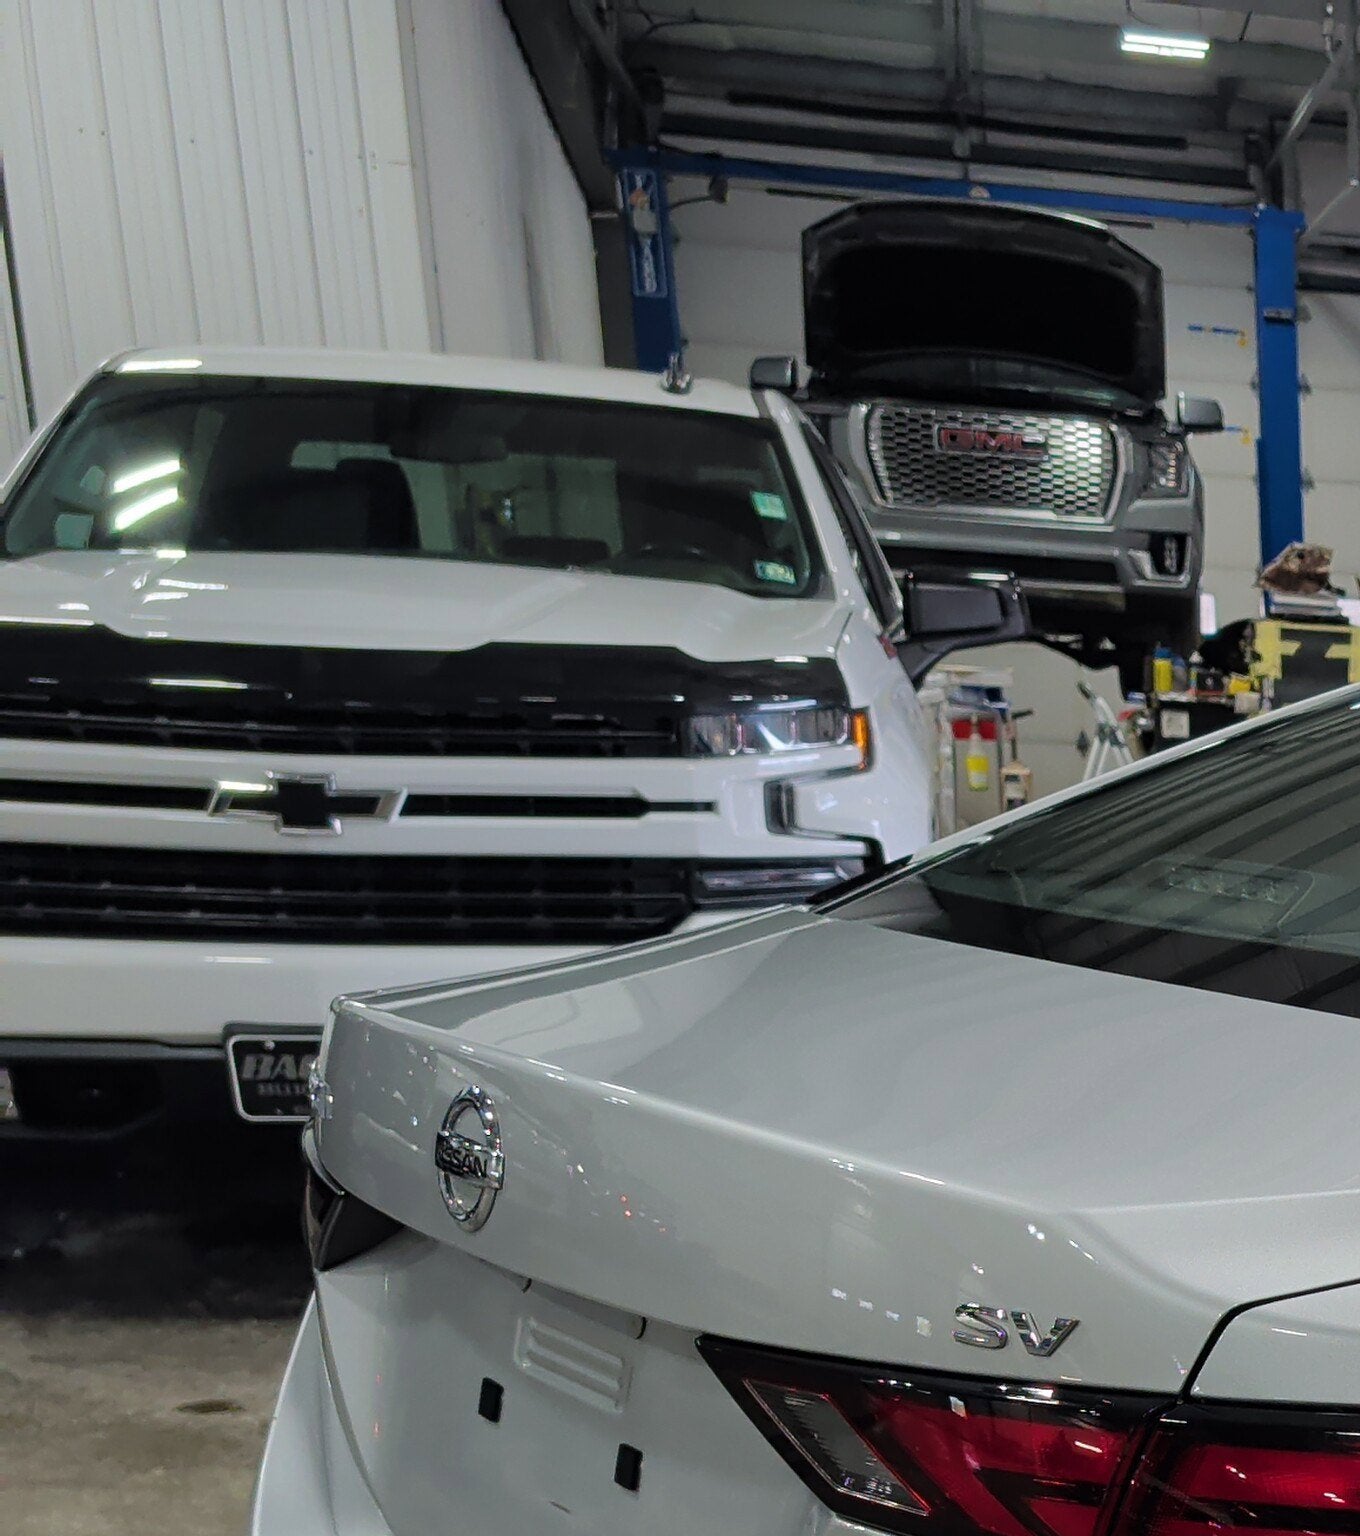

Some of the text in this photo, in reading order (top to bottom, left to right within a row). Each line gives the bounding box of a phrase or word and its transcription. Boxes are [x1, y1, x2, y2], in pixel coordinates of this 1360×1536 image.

[941, 428, 1045, 456] GMC
[438, 1143, 487, 1178] SSAN
[952, 1301, 1081, 1357] SV
